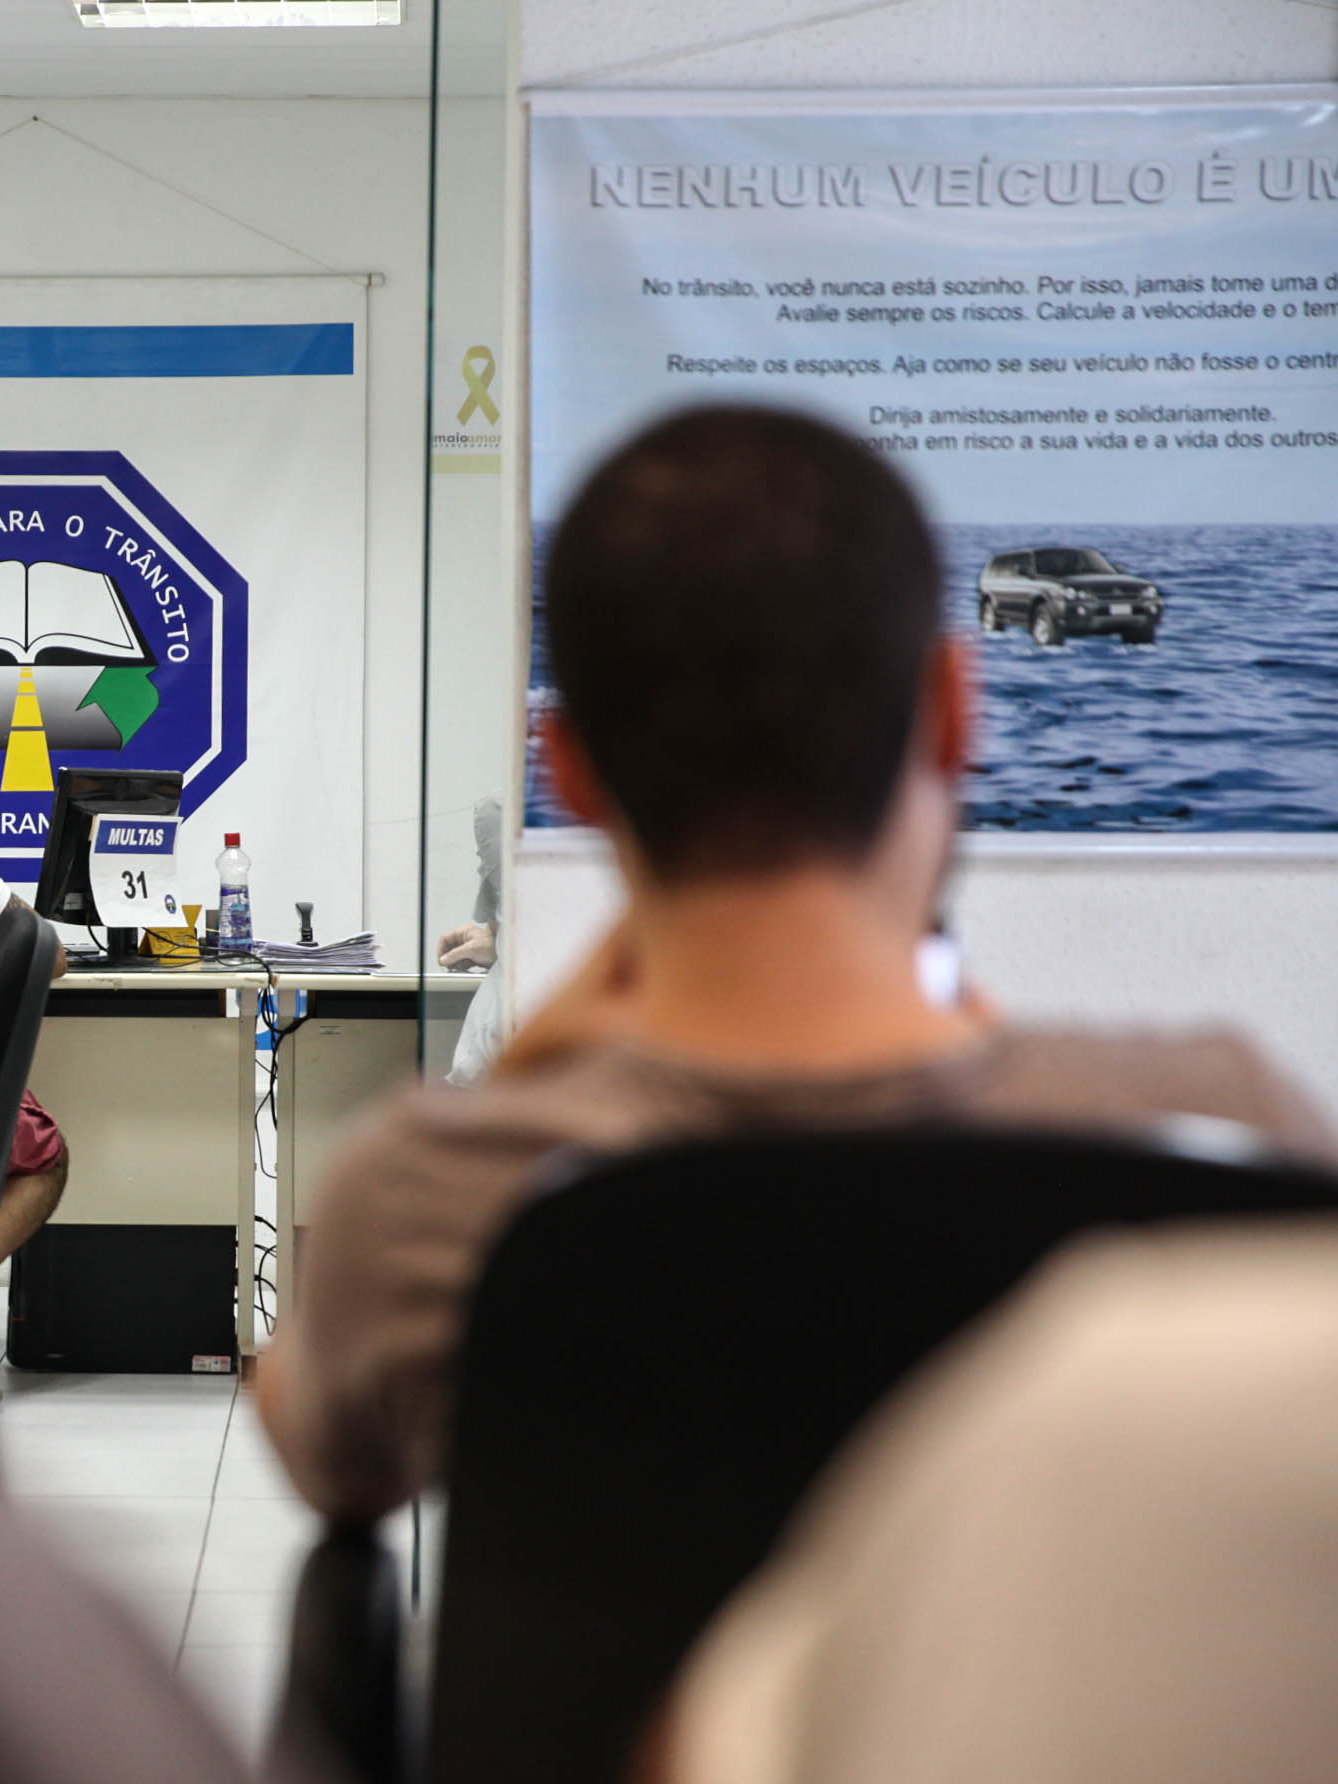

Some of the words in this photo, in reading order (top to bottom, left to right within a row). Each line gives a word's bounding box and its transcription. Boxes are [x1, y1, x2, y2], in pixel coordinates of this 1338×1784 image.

[589, 162, 865, 208] NENHUM
[887, 152, 1174, 207] VEÍCULO
[1197, 149, 1238, 204] É
[642, 277, 672, 296] No
[678, 276, 760, 298] trânsito,
[766, 277, 814, 297] você
[822, 279, 885, 296] nunca
[892, 276, 936, 296] está
[943, 275, 1029, 296] sozinho.
[1037, 275, 1074, 295] Por
[1081, 275, 1129, 297] isso,
[1134, 274, 1205, 298] jamais
[1210, 274, 1264, 293] tome
[1271, 276, 1318, 292] uma
[776, 302, 840, 323] Avalie
[846, 305, 925, 326] sempre
[931, 306, 955, 322] os
[963, 302, 1029, 322] riscos.
[1037, 301, 1116, 321] Calcule
[1121, 305, 1135, 320] a
[1142, 299, 1257, 320] velocidade
[1262, 303, 1276, 318] e
[1282, 303, 1297, 318] o
[667, 354, 758, 378] Respeite
[764, 357, 786, 374] os
[795, 357, 887, 379] espaços.
[893, 354, 926, 379] Aja
[933, 358, 992, 374] como
[997, 358, 1022, 373] se
[1029, 357, 1066, 373] seu
[1073, 352, 1149, 372] veículo
[1155, 352, 1195, 372] não
[1202, 351, 1259, 371] fosse
[1265, 355, 1279, 370] o
[869, 406, 922, 429] Dirija
[928, 405, 1089, 425] amistosamente
[1095, 408, 1109, 424] e
[1115, 404, 1277, 423] solidariamente.
[925, 434, 958, 450] em
[963, 432, 1014, 450] risco
[1020, 434, 1033, 450] a
[1040, 434, 1078, 450] sua
[1084, 431, 1128, 450] vida
[1134, 434, 1148, 449] e
[1154, 434, 1168, 449] a
[1174, 430, 1218, 449] vida
[1224, 429, 1263, 449] dos
[1270, 430, 1338, 448] outros
[65, 515, 84, 537] O
[104, 525, 190, 662] TRÂNSITO
[108, 827, 164, 846] MULTAS
[121, 870, 148, 899] 31
